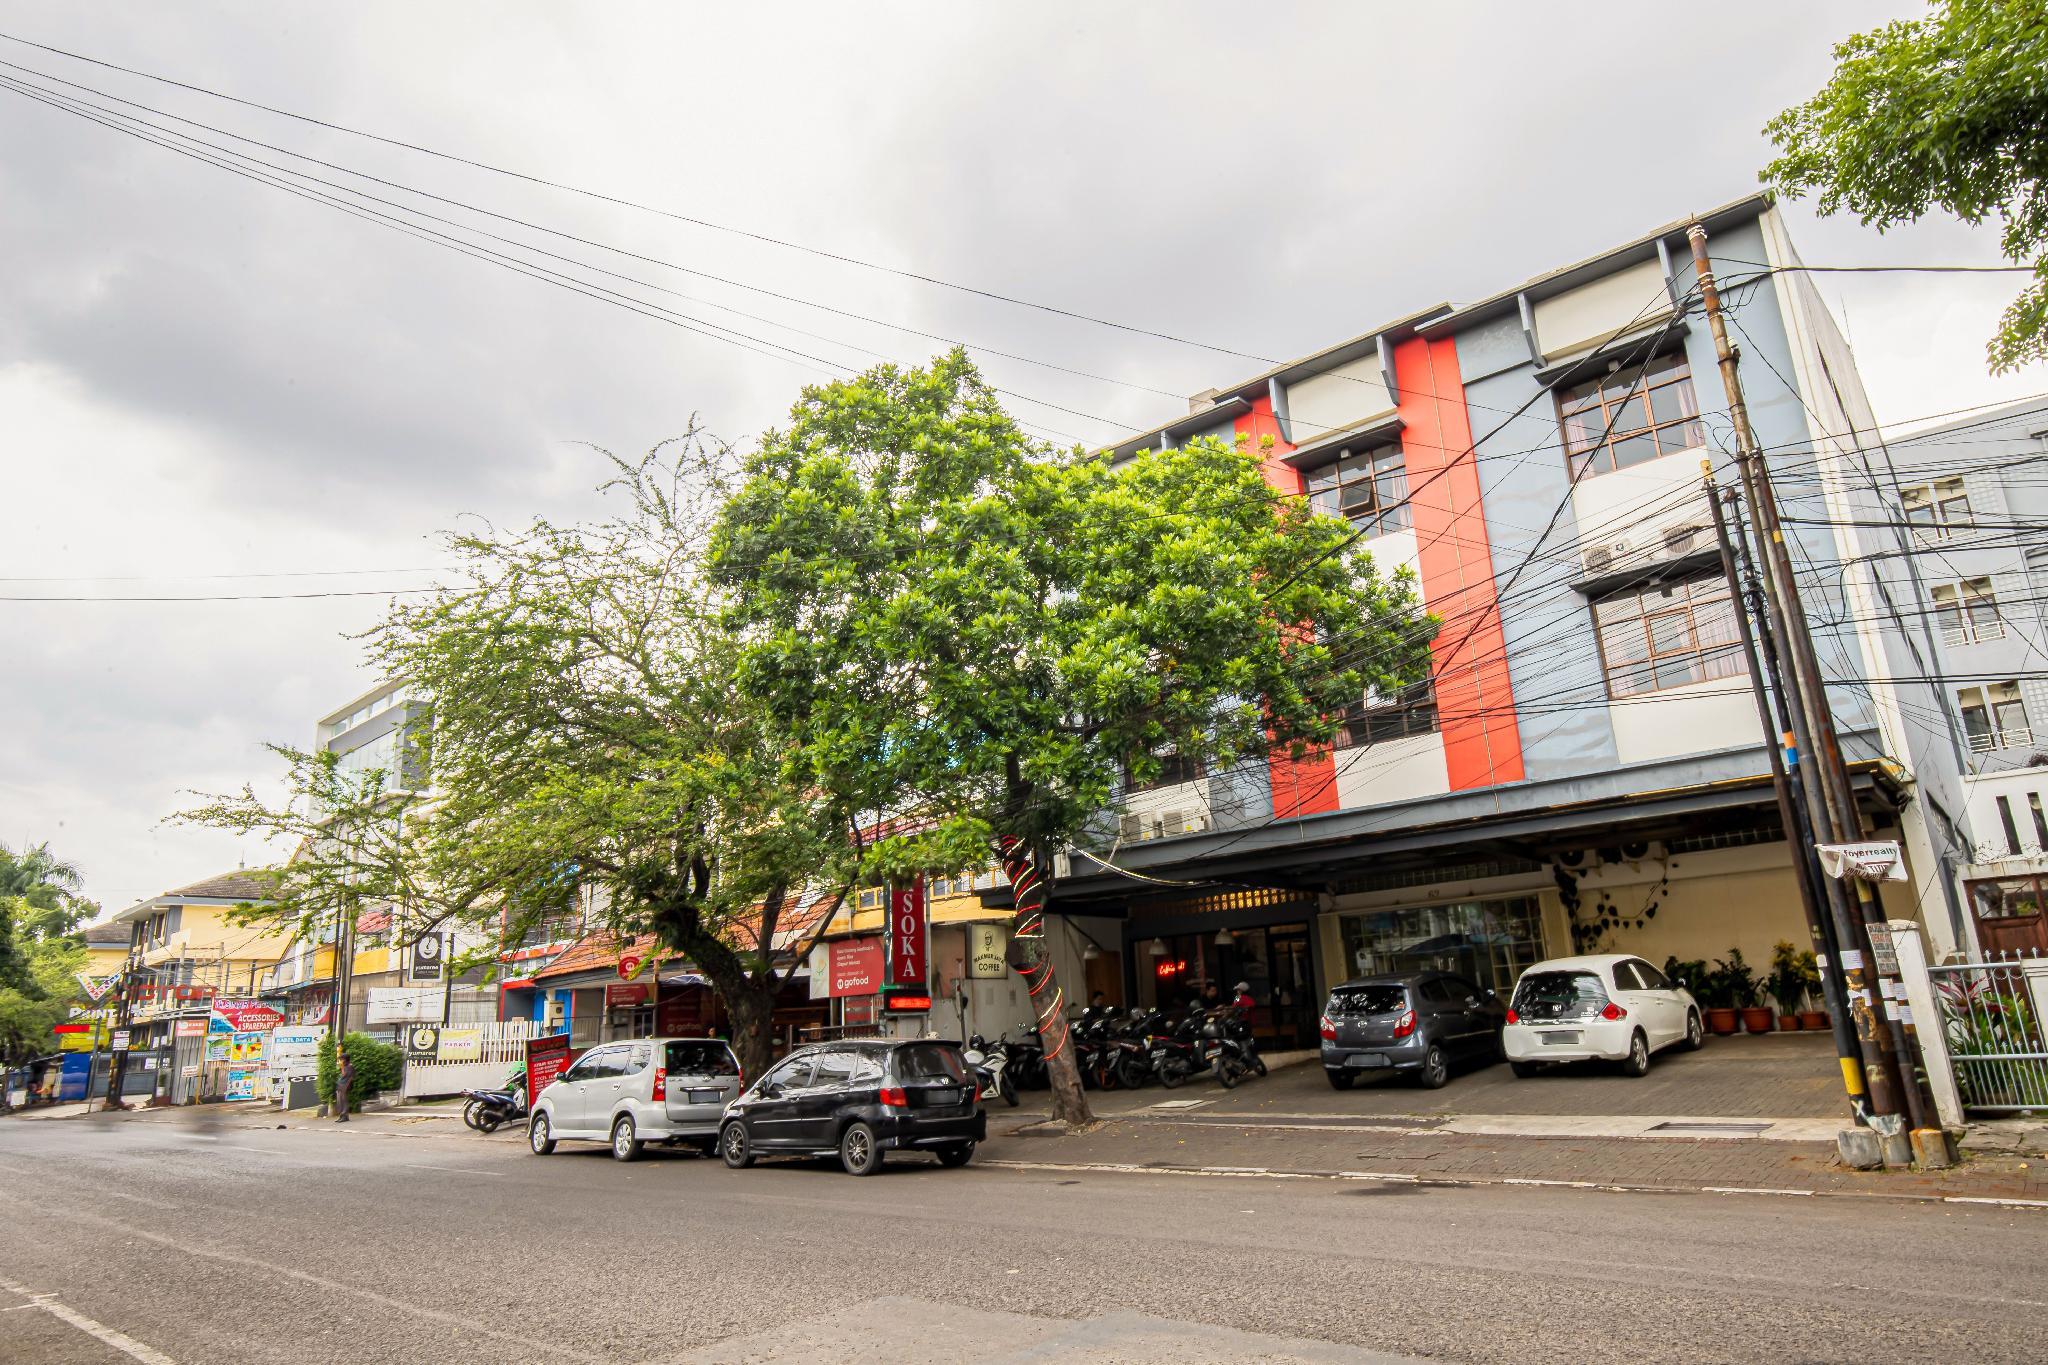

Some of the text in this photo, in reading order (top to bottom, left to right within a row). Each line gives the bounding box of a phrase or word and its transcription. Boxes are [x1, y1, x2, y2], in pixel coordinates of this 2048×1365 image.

[978, 963, 1000, 972] COFFEE
[844, 976, 869, 989] gofood
[238, 1014, 280, 1023] ACCESSORIES
[242, 1021, 275, 1031] SPAREPART
